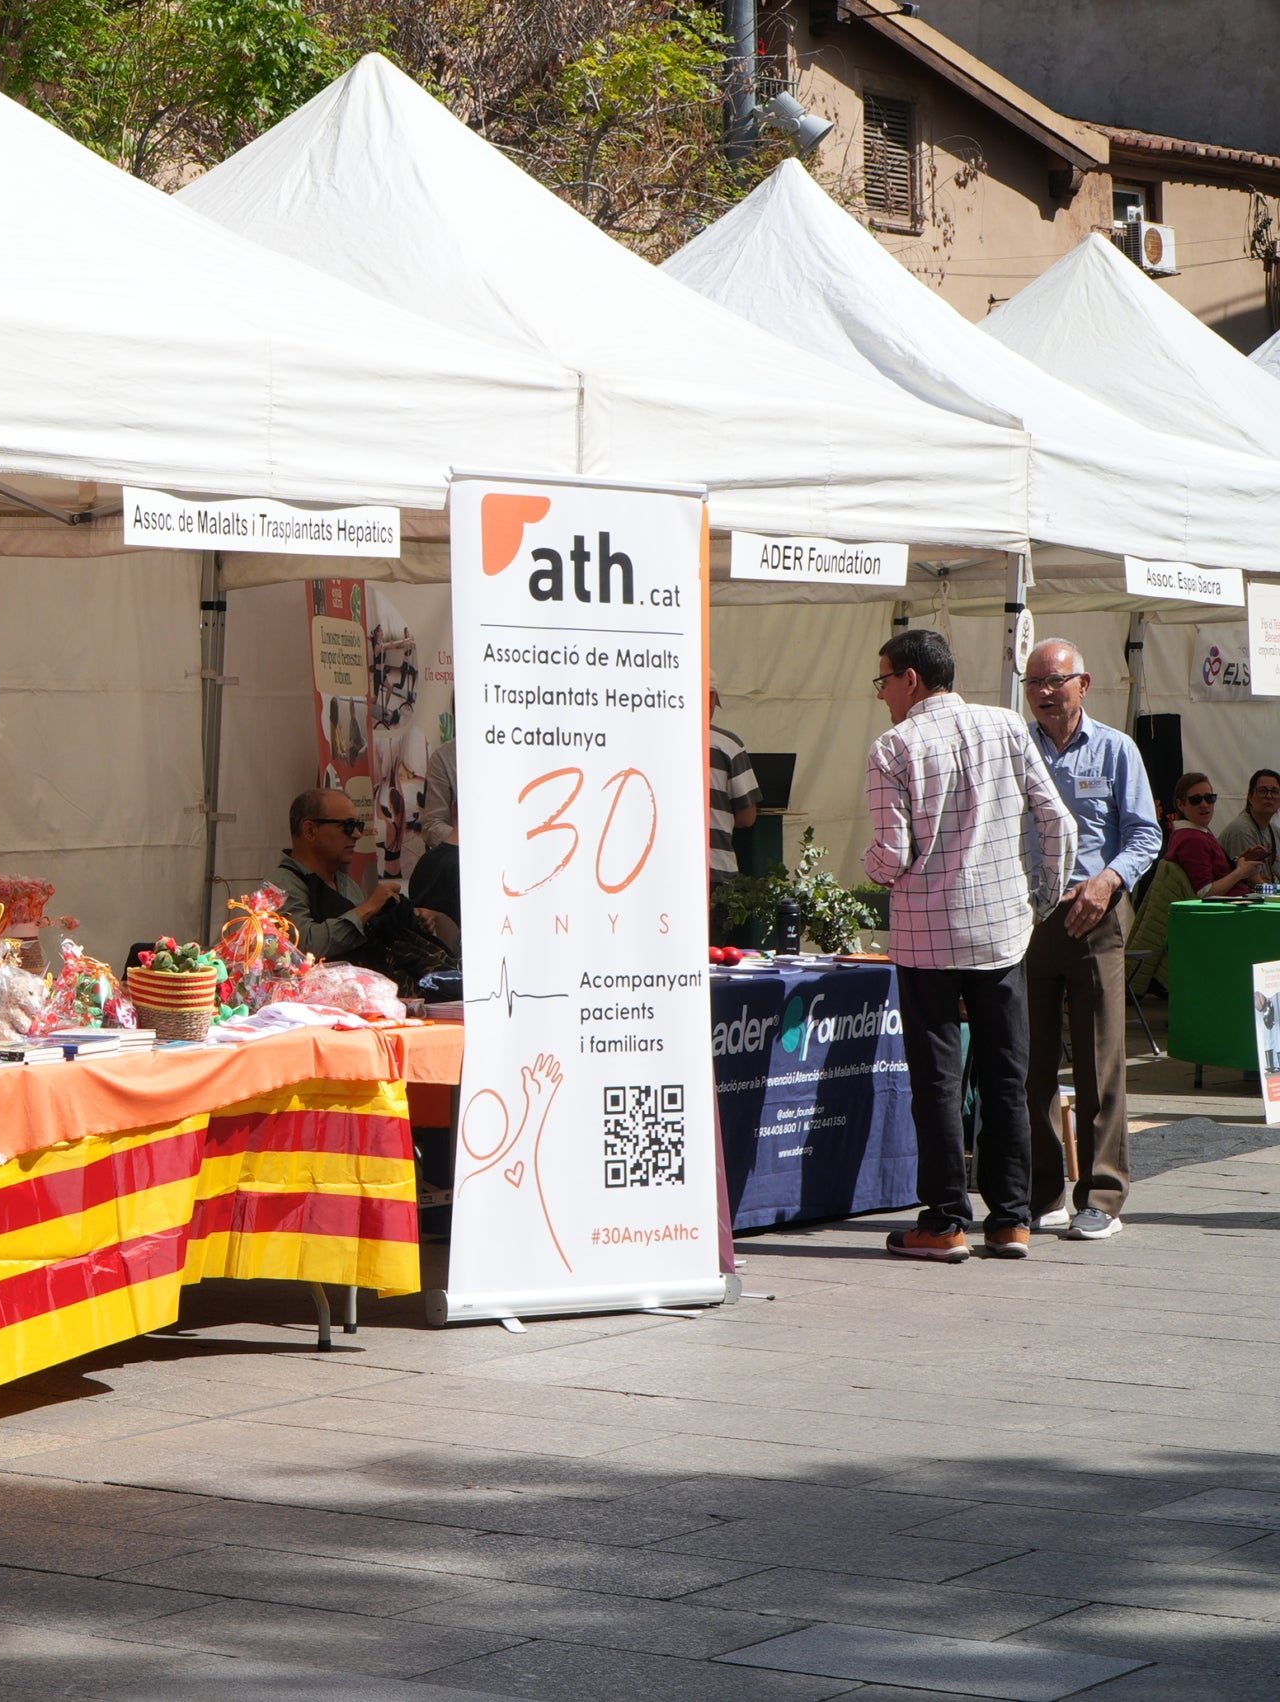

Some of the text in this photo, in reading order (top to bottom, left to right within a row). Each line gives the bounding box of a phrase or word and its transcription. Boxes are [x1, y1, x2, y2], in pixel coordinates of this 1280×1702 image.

[133, 503, 394, 548] Assoc. de Malalts i Trasplantats Hepàtics
[760, 543, 881, 575] ADER Foundation
[1146, 567, 1176, 588] Assoc.
[1197, 575, 1221, 595] Sacra
[483, 643, 679, 669] Associació de Malalts
[484, 683, 685, 712] i Trasplantats Hepàtics
[485, 725, 606, 751] de Catalunya
[501, 766, 657, 897] 30
[579, 970, 702, 991] Acompanyant
[580, 1003, 655, 1025] pacients
[580, 1035, 664, 1053] i familiars
[860, 1061, 879, 1074] Renal
[591, 1224, 700, 1247] #30AnysAthc
